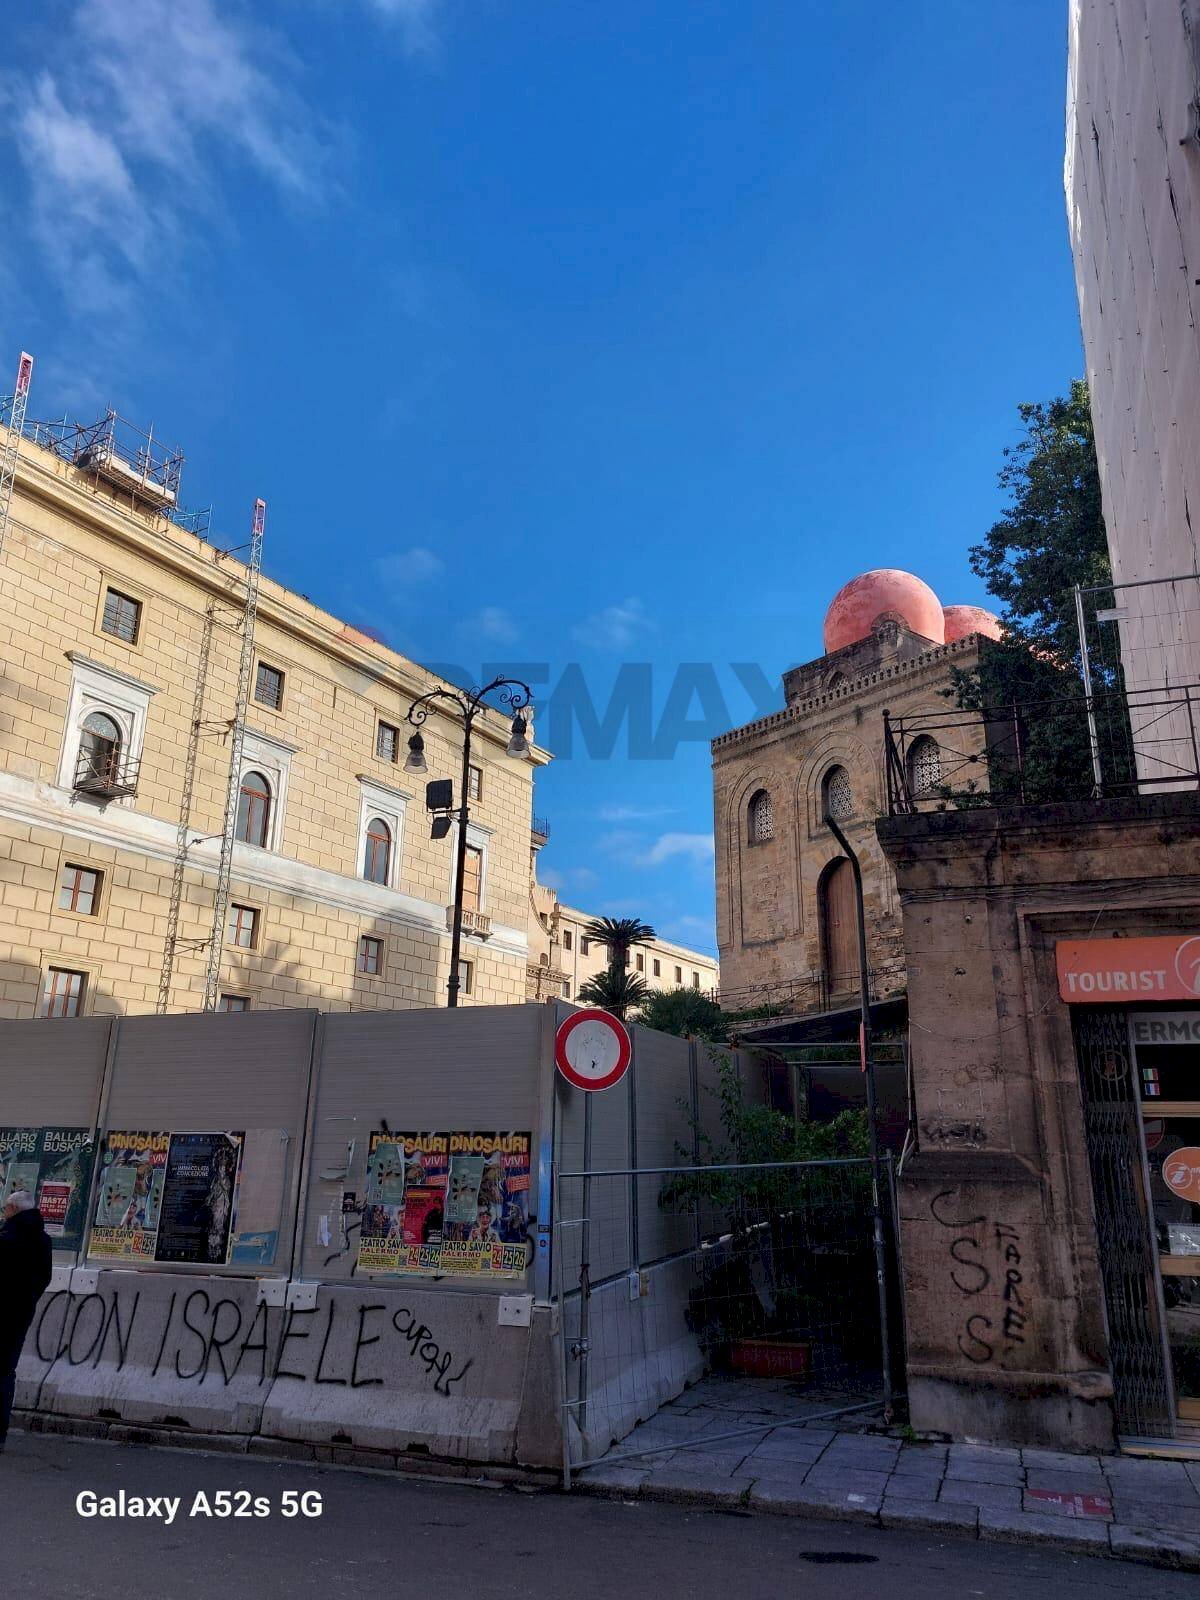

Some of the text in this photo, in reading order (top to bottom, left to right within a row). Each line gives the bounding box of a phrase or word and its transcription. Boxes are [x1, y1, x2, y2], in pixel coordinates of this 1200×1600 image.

[1064, 970, 1167, 993] TOURIST
[43, 1141, 93, 1153] BUSKES
[450, 1135, 528, 1154] DINOSAURI
[424, 1155, 443, 1166] VIVI
[504, 1155, 524, 1166] VIVI
[361, 1238, 386, 1248] TEATRO
[469, 1242, 492, 1252] SAVIO
[360, 1247, 399, 1255] PALERMO
[36, 1289, 386, 1388] CON ISRAELE
